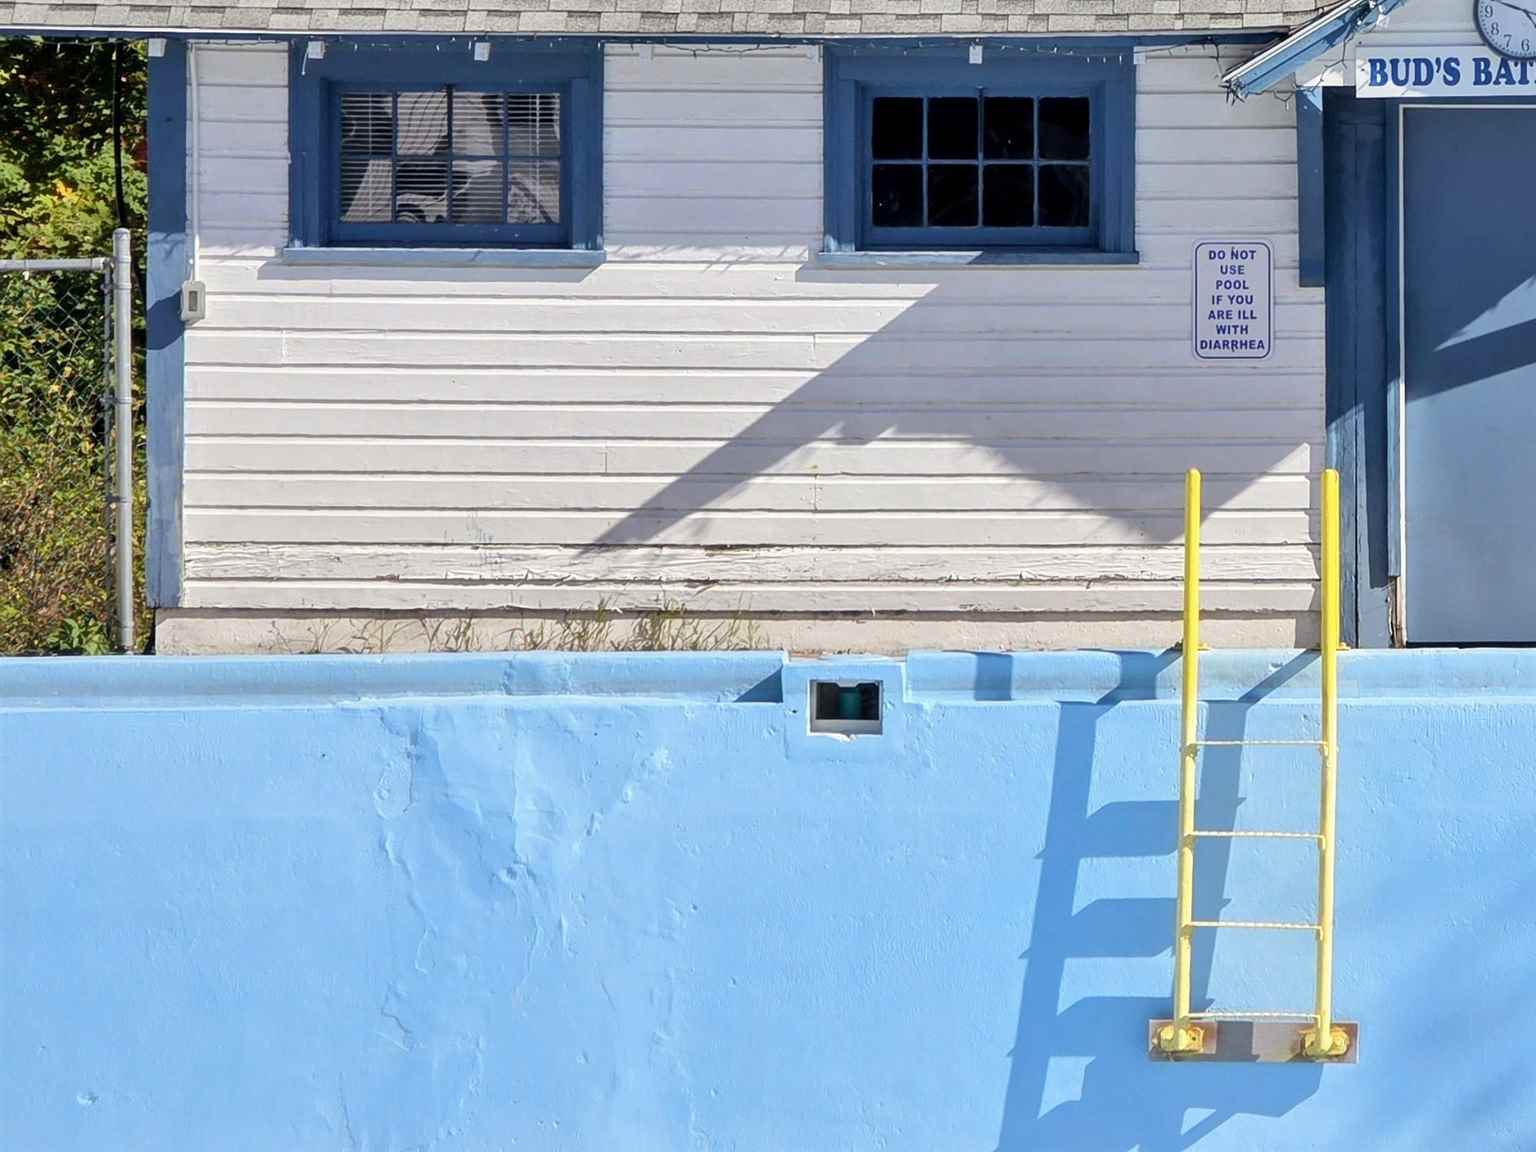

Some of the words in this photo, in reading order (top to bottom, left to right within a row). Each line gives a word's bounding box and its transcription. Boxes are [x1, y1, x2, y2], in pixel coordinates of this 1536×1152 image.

[1485, 5, 1493, 18] 9
[1491, 23, 1499, 35] 8
[1504, 35, 1512, 48] 7
[1521, 39, 1530, 52] 6
[1368, 57, 1461, 87] BUD'S
[1209, 250, 1226, 260] DO
[1231, 250, 1256, 260] NOT
[1220, 265, 1245, 275] USE
[1216, 280, 1249, 289] POOL
[1212, 295, 1223, 304] IF
[1228, 295, 1253, 304] YOU
[1208, 310, 1232, 320] ARE
[1238, 310, 1257, 319] ILL
[1216, 325, 1248, 335] WITH
[1200, 340, 1265, 350] DIARRHEA
